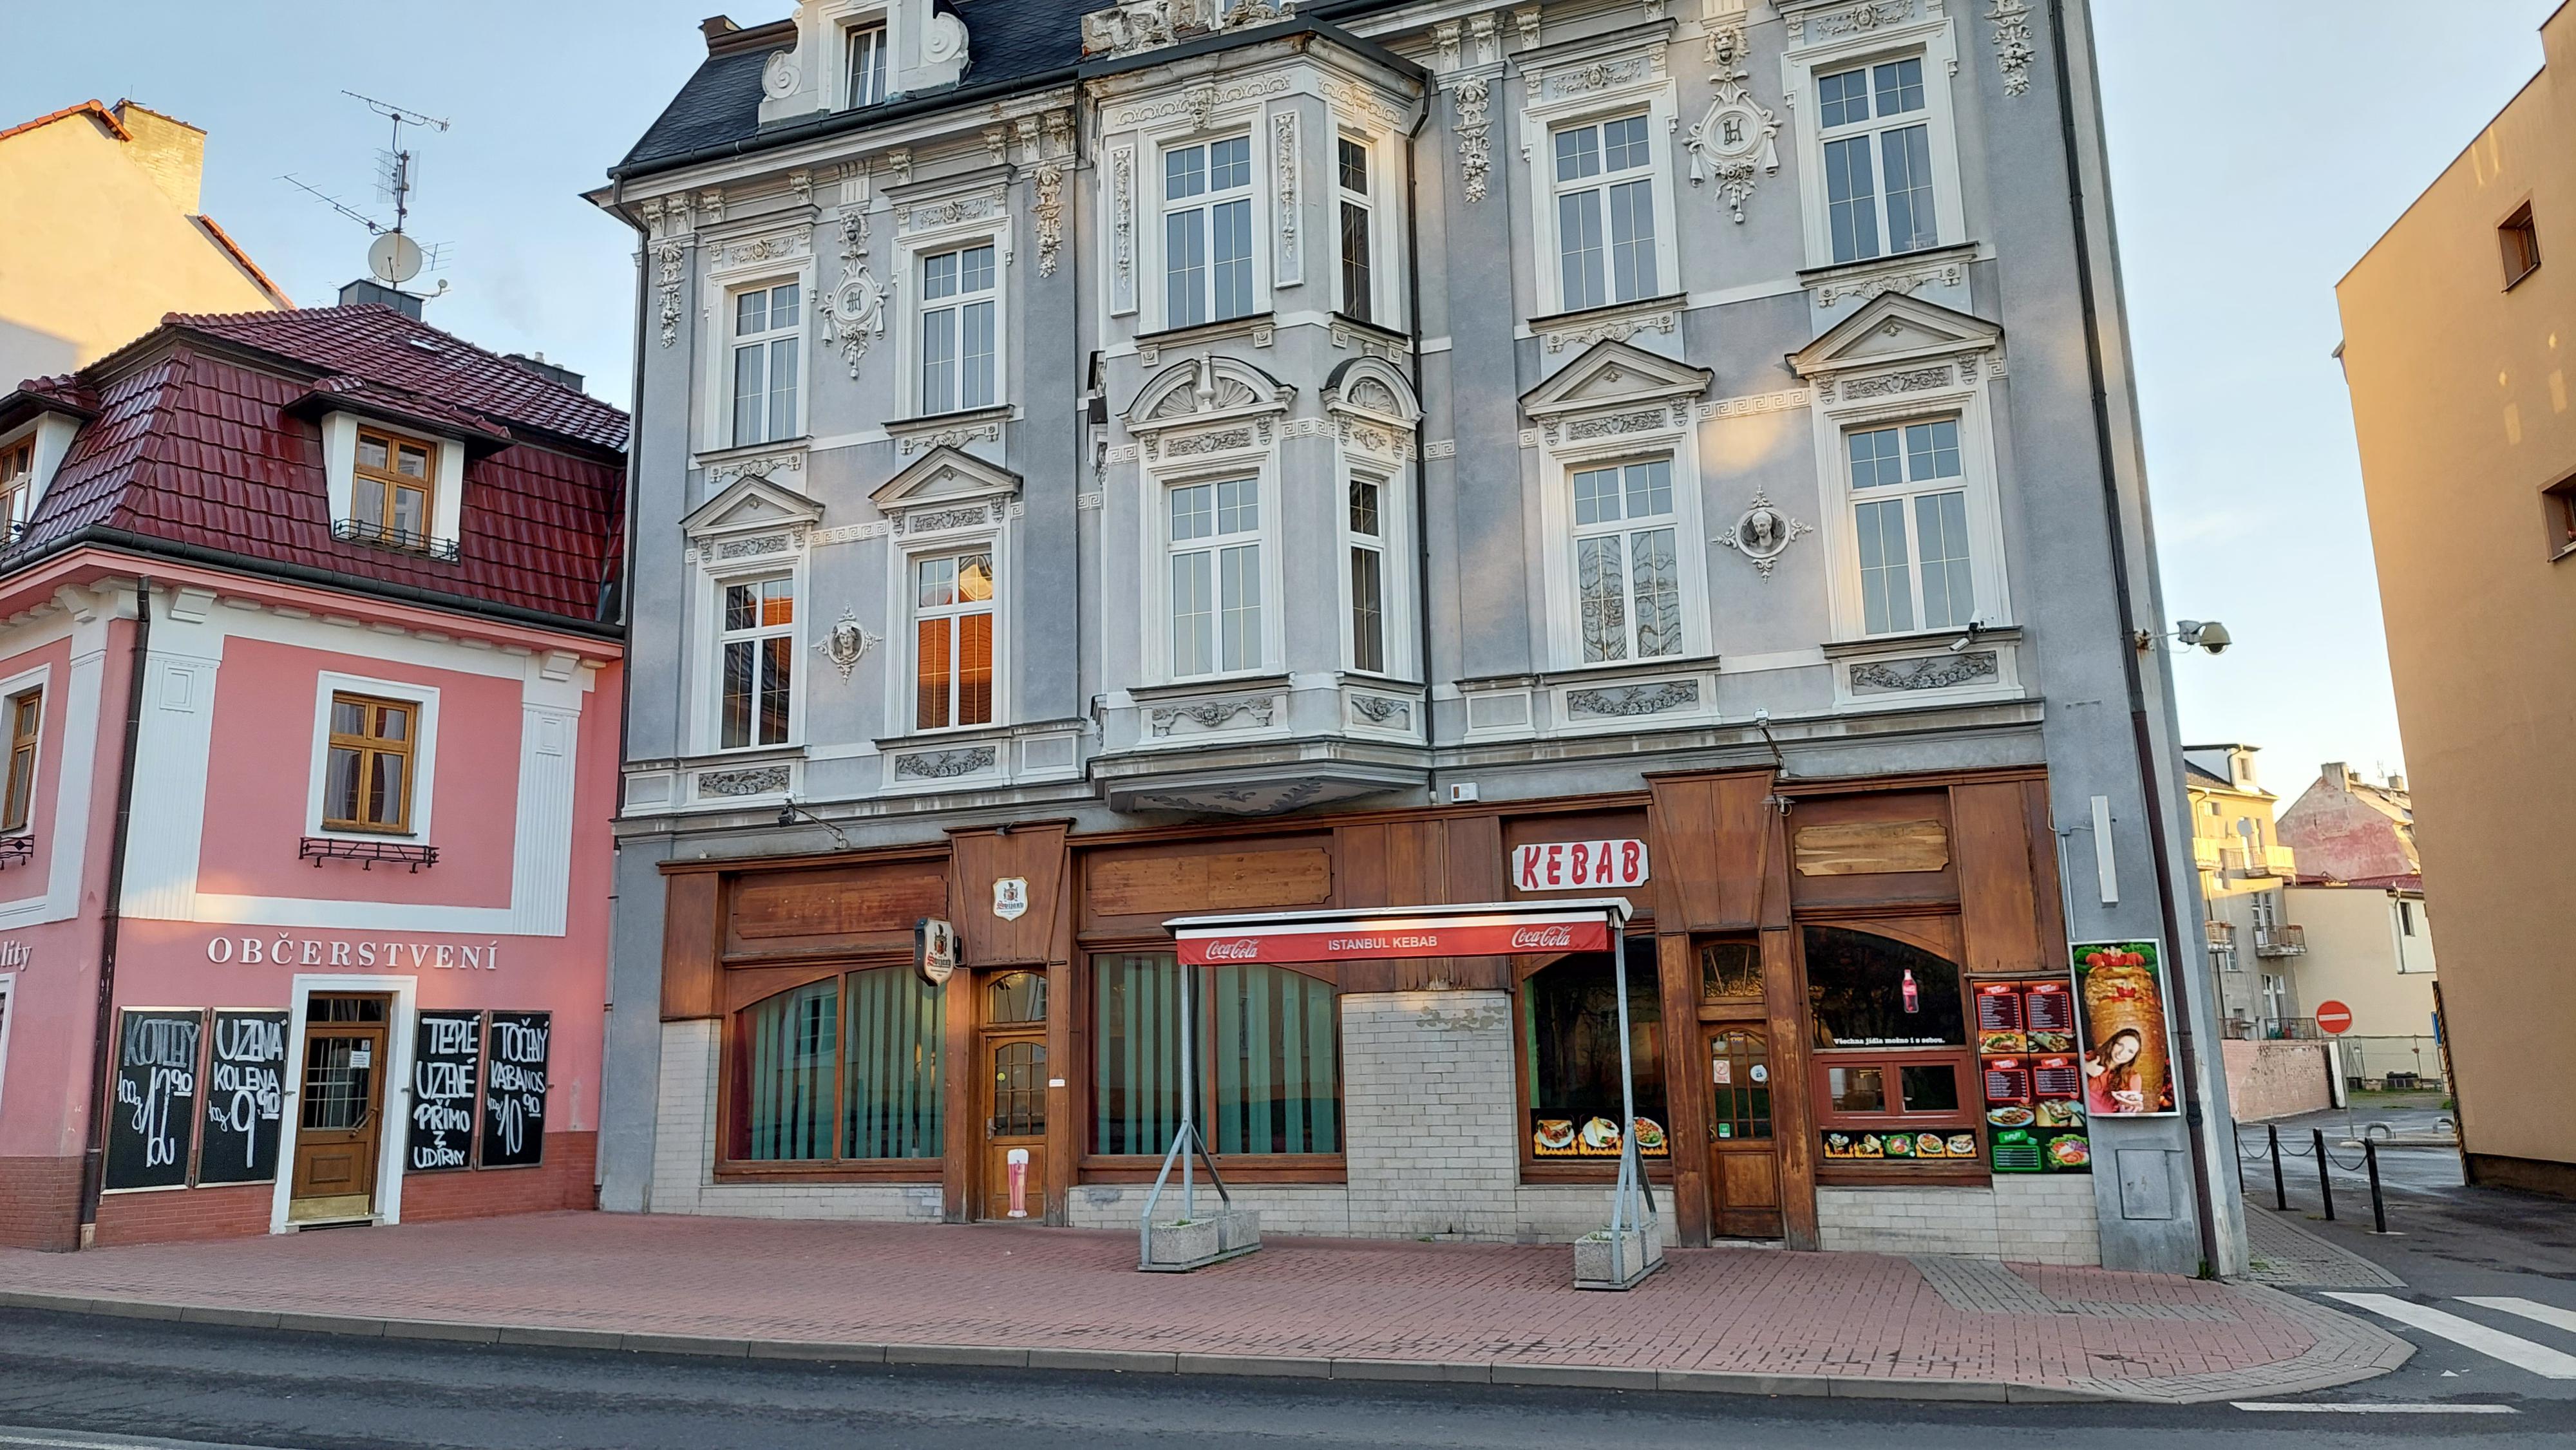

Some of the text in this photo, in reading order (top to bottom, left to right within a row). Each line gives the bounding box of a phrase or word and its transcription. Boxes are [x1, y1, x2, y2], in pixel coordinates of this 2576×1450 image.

[1522, 842, 1640, 889] KEBAB
[207, 932, 498, 970] OBČERSTVENÍ
[1206, 939, 1260, 959] Coca-Cola
[1329, 936, 1437, 951] ISTANBUL KEBAB
[1511, 925, 1573, 948] Coca-Cola
[422, 1015, 480, 1054] TEPLÉ
[492, 1017, 549, 1062] TOČENÝ
[214, 1062, 281, 1094] KOLENA
[416, 1057, 476, 1099] UZENÉ
[490, 1060, 545, 1093] KABANOS
[118, 1069, 142, 1130] 100g
[209, 1100, 231, 1132] 100g
[413, 1099, 470, 1133] PŘÍMO
[487, 1093, 504, 1120] 100g
[433, 1131, 446, 1145] Z
